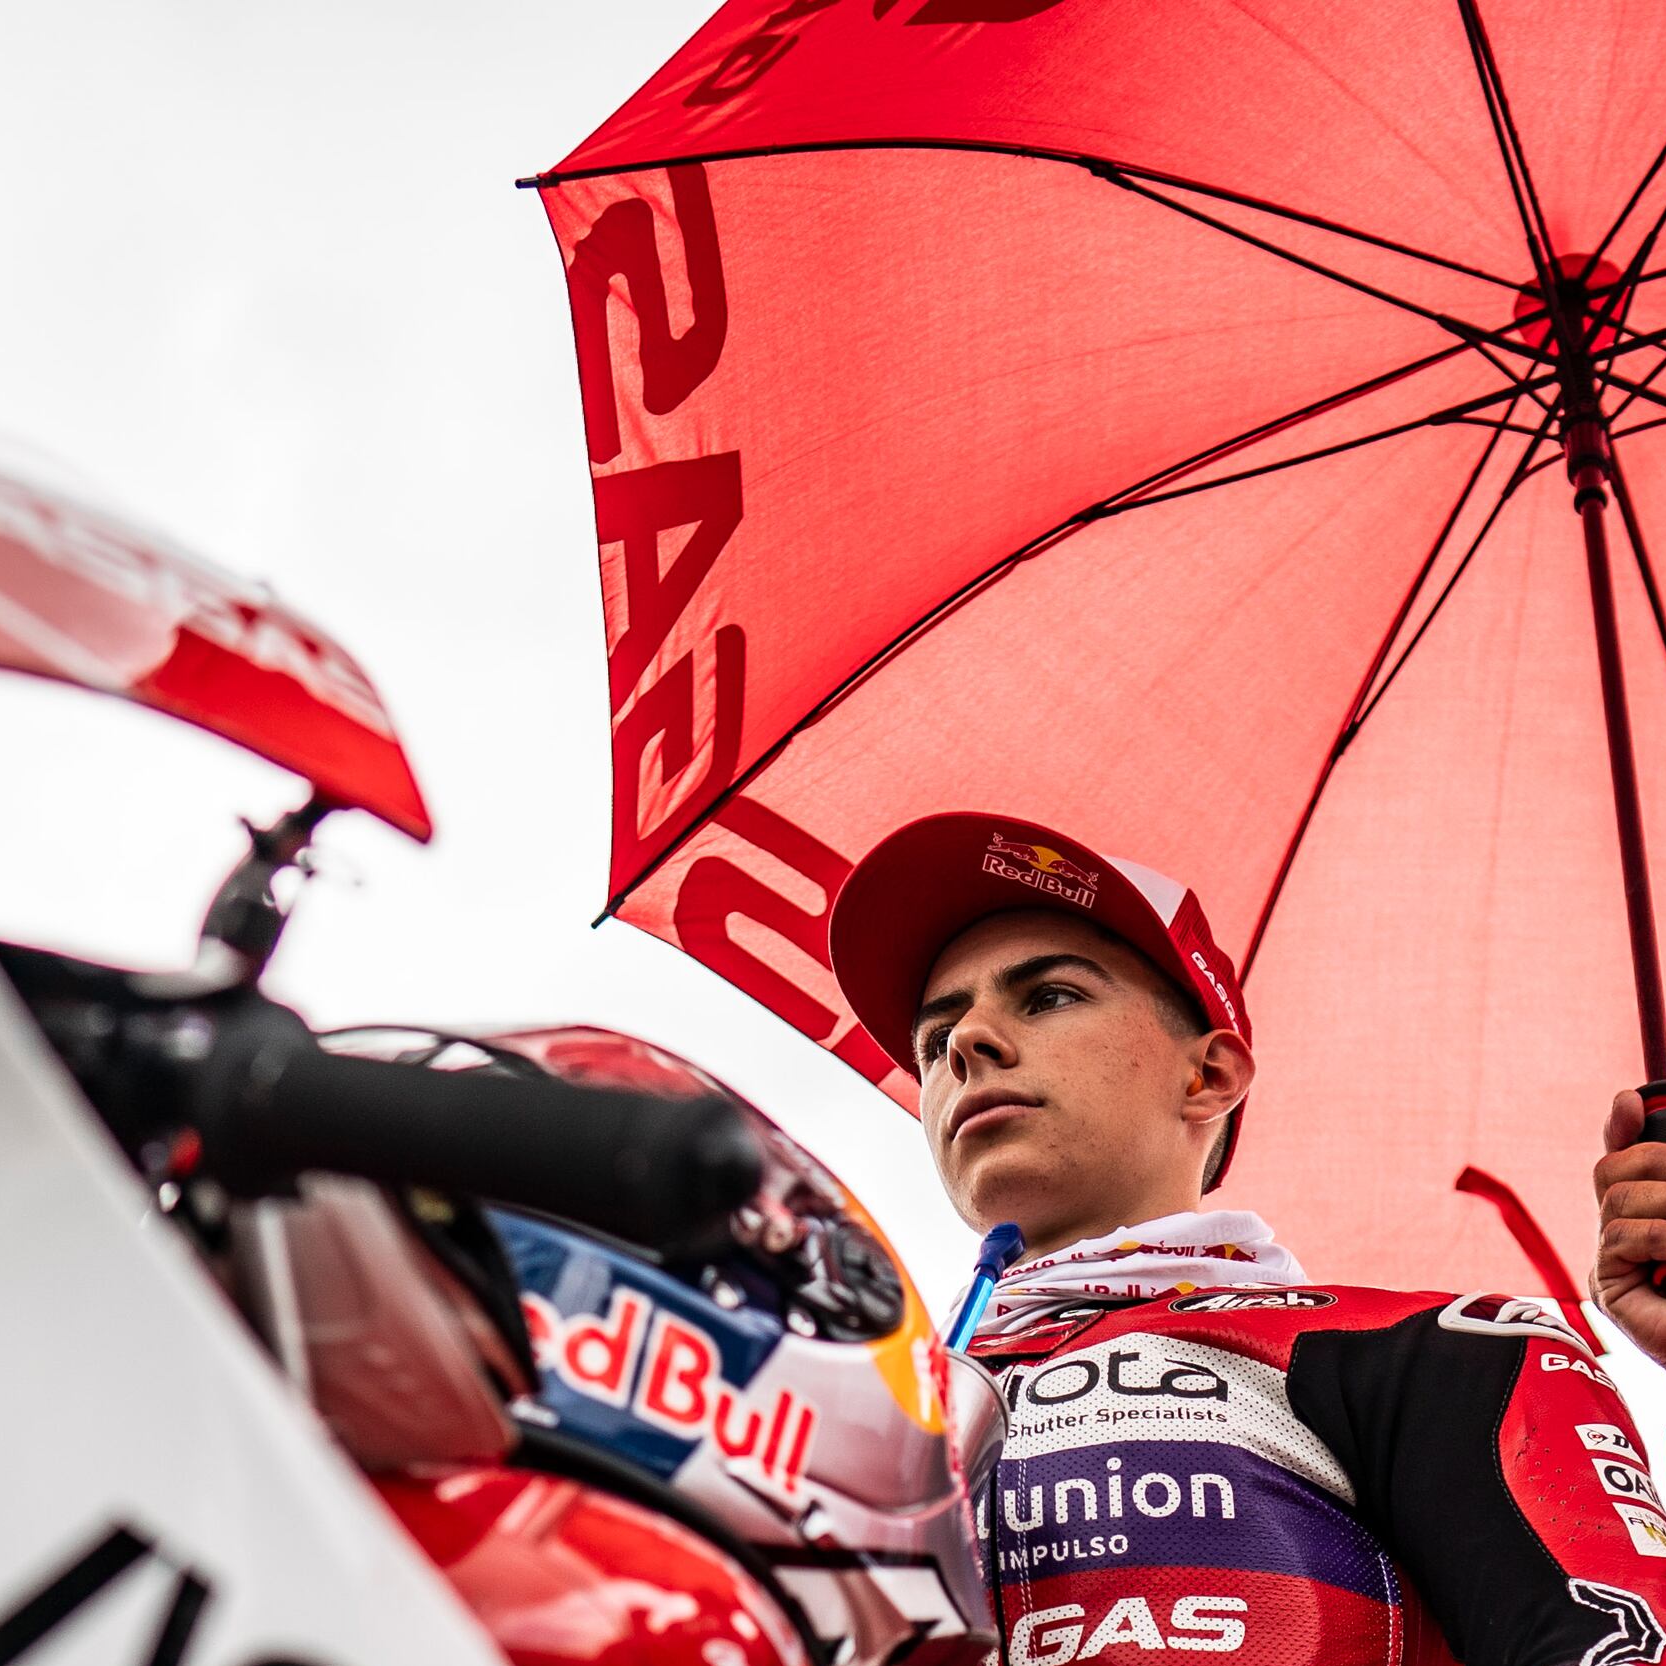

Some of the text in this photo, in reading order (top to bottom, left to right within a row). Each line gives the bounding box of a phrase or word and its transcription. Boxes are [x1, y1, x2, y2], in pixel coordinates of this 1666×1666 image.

[645, 1318, 814, 1488] Bull
[1008, 1350, 1229, 1413] iota
[1096, 1406, 1228, 1426] Specialists
